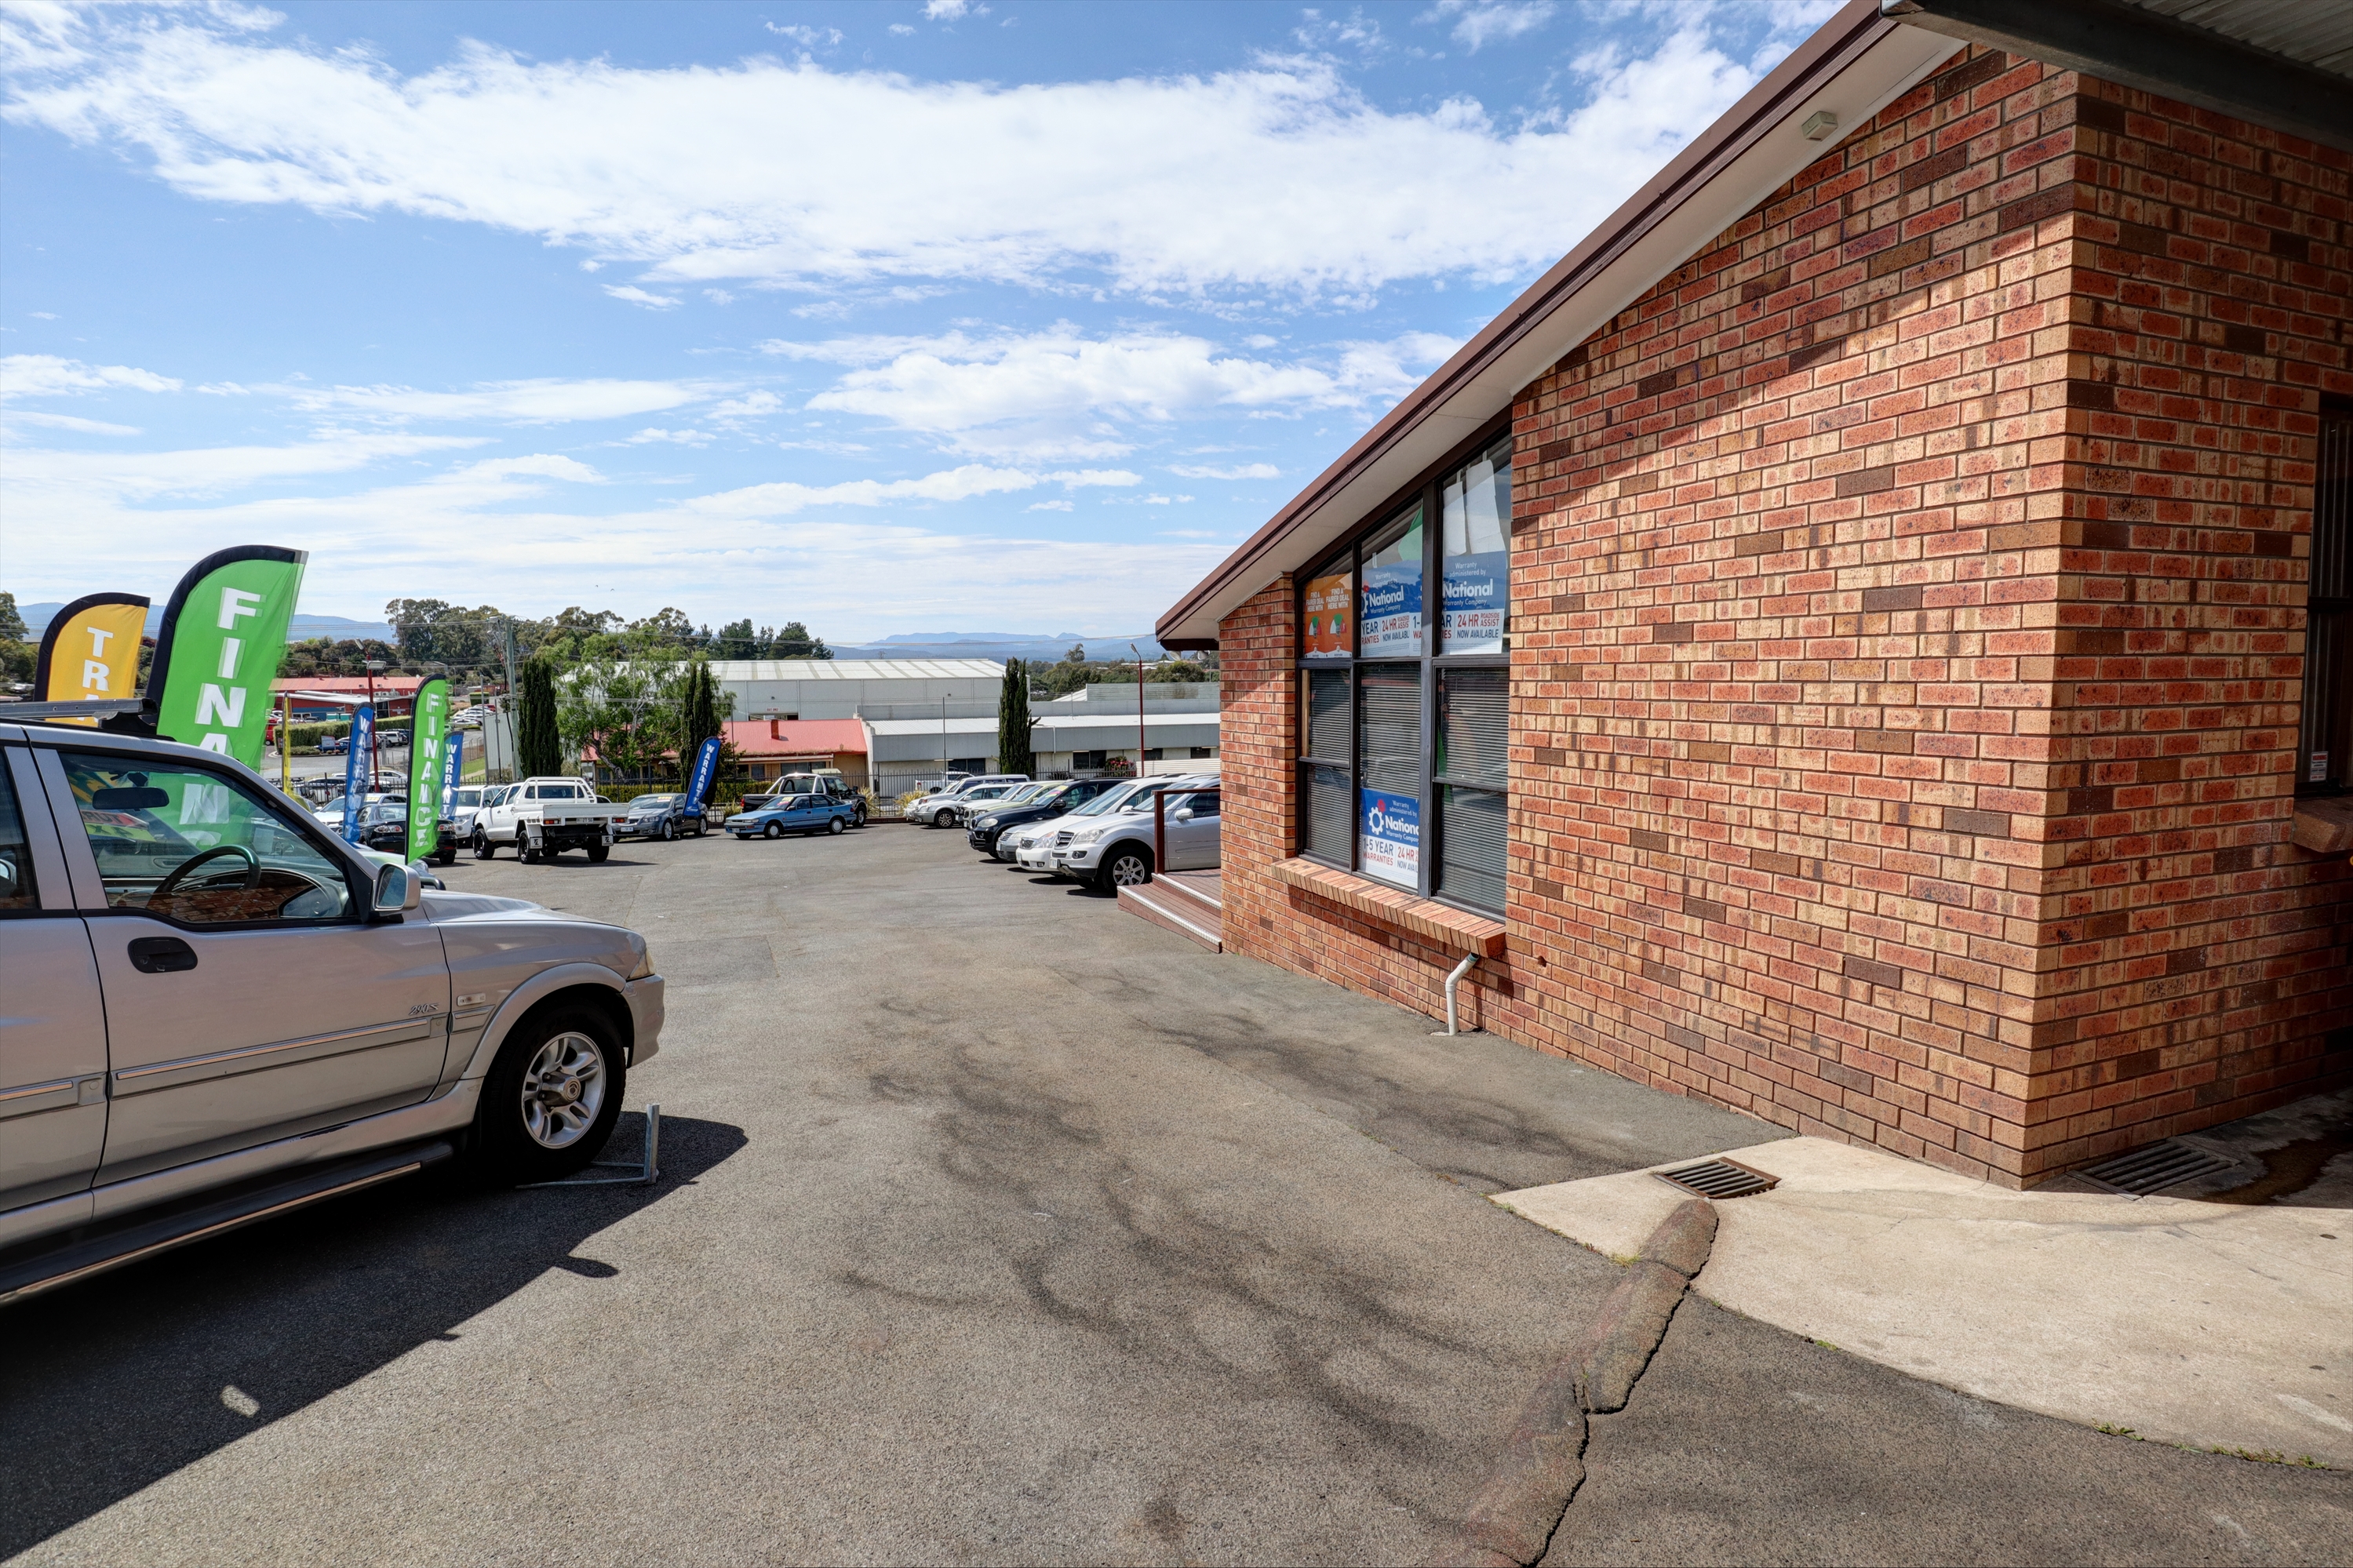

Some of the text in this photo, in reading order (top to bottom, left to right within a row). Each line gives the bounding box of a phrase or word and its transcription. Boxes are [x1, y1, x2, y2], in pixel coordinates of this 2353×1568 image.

[1449, 569, 1480, 578] administered
[1443, 578, 1493, 598] National
[1369, 585, 1404, 607] National
[1385, 604, 1401, 613] Company
[1361, 620, 1379, 635] YEAR
[1382, 620, 1389, 632] 24
[1390, 617, 1397, 631] HR
[1457, 615, 1466, 628] 24
[1468, 613, 1479, 628] HR
[1481, 619, 1499, 628] ASSIST
[1382, 633, 1391, 642] NOW
[1456, 630, 1470, 638] NOW
[1470, 629, 1499, 638] AVAILABLE
[414, 693, 443, 848] FINANCE
[692, 743, 716, 805] WARRANTY
[1392, 800, 1409, 809] Warranty
[1390, 806, 1418, 818] administered by
[1386, 830, 1402, 840] Warranty
[1363, 838, 1373, 851] 1-5
[1375, 840, 1393, 857] YEAR
[1397, 846, 1405, 858] 24
[1406, 849, 1415, 862] HR
[1362, 850, 1393, 866] WARRANTIES
[1397, 860, 1407, 869] NOW
